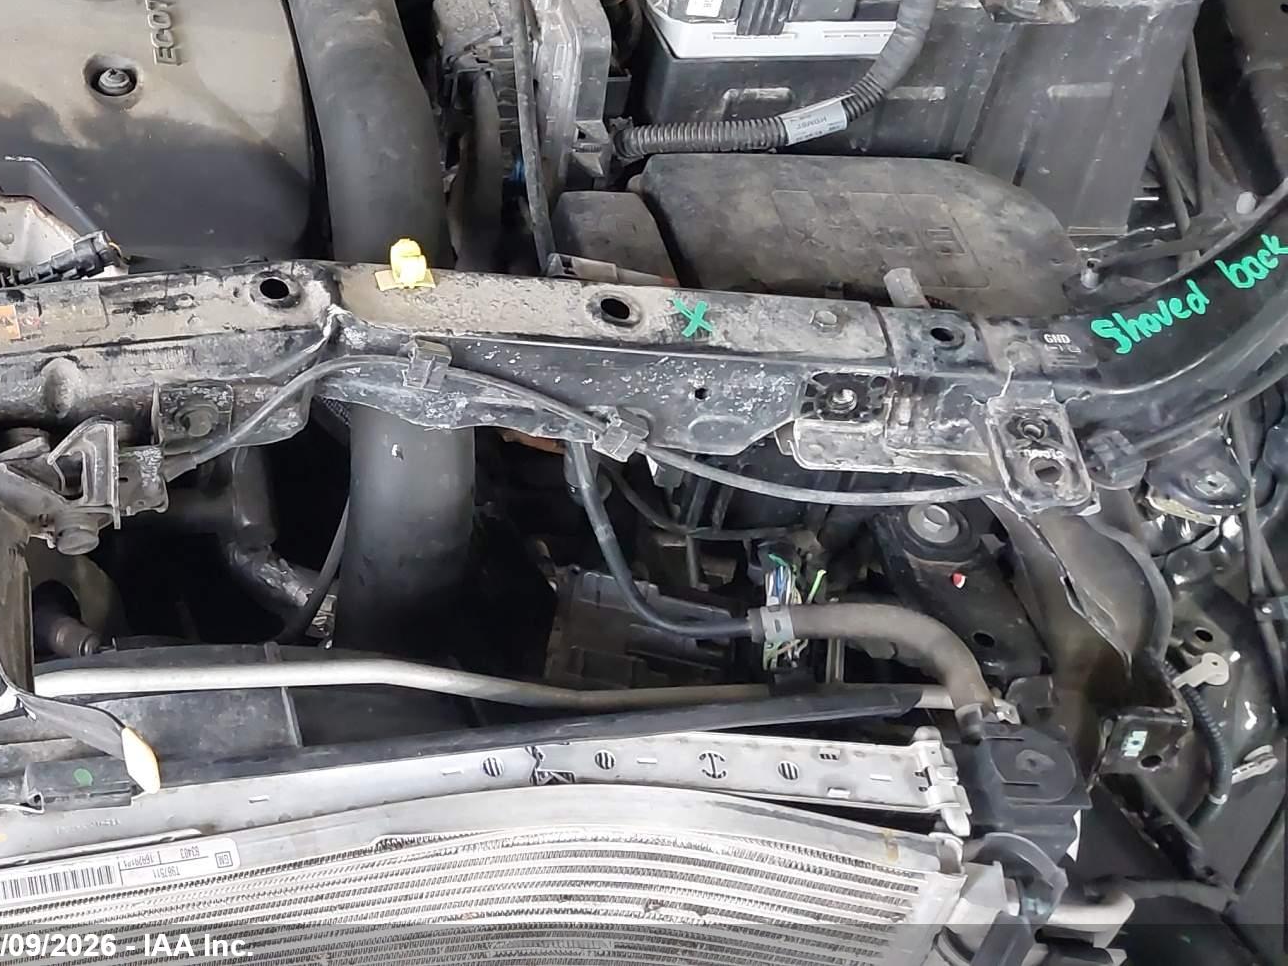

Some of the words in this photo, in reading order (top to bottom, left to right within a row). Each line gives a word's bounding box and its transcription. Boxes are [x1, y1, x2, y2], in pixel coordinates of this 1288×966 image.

[1090, 278, 1211, 355] Shoved
[1214, 233, 1288, 289] back
[1043, 333, 1071, 344] GND
